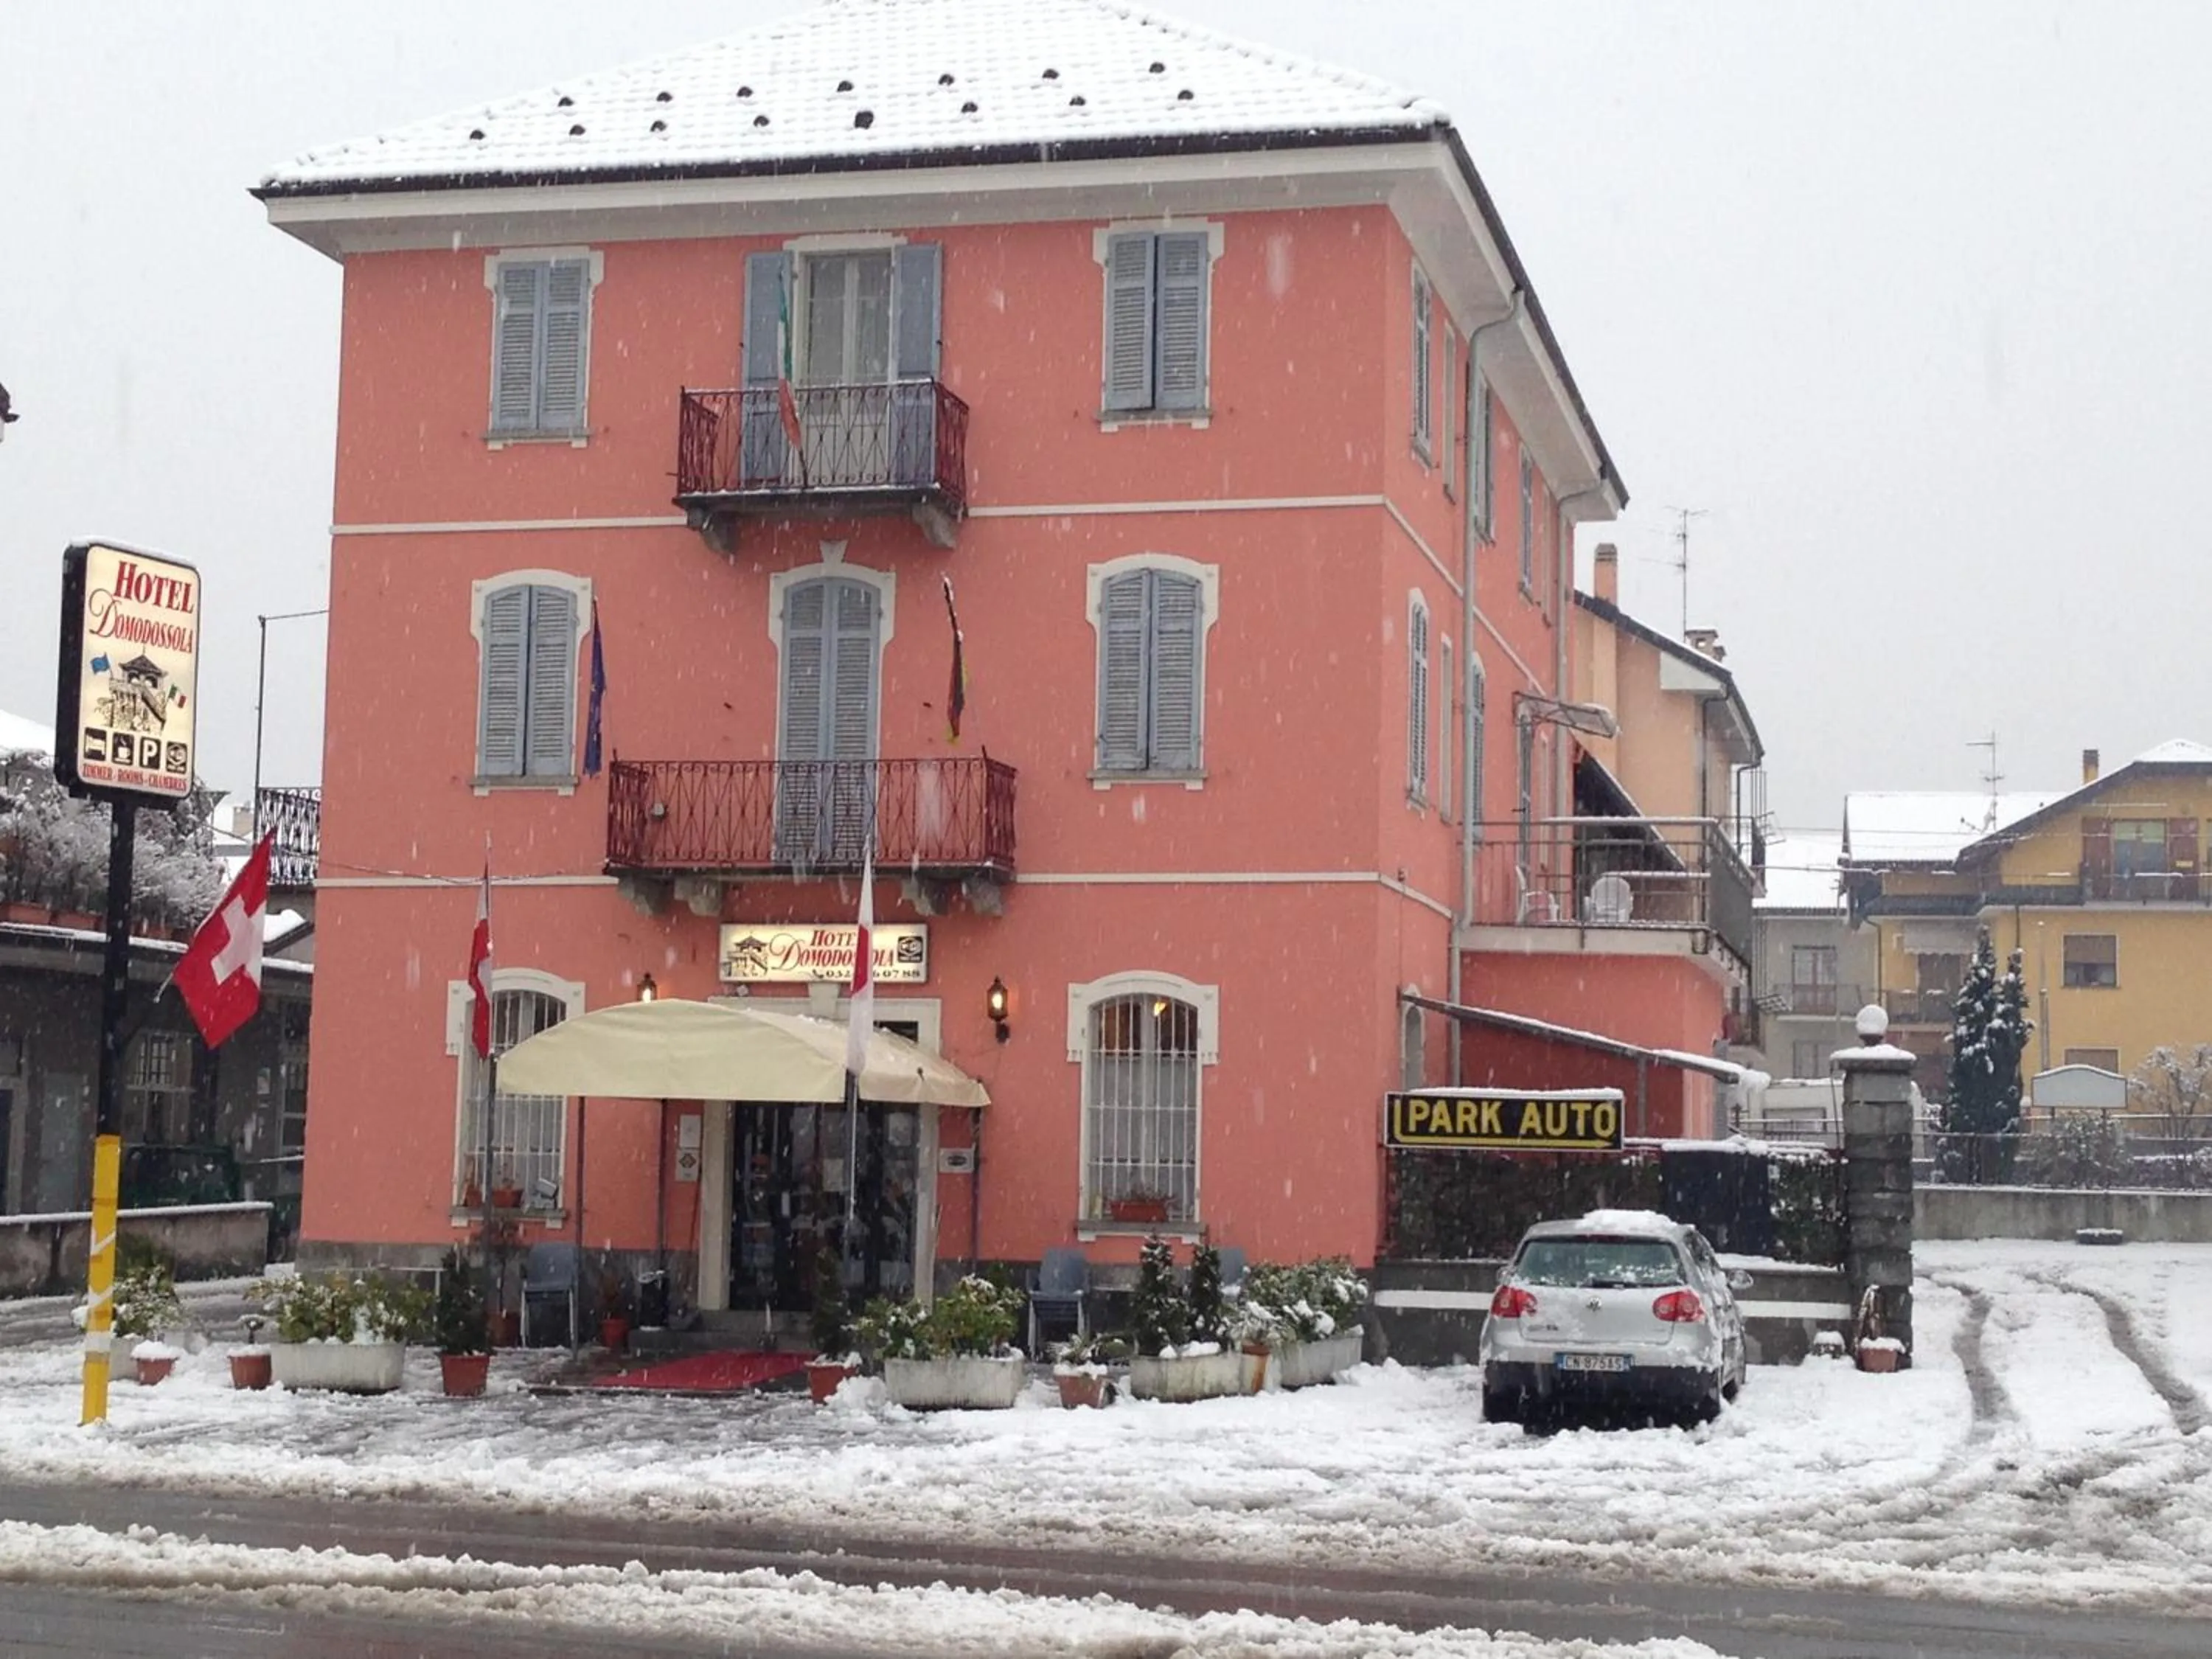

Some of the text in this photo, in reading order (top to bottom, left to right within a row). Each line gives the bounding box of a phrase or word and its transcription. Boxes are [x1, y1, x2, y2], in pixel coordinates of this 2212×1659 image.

[114, 560, 194, 614] HOTEL
[810, 930, 858, 947] HOTE
[1408, 1099, 1616, 1138] PARK AUTO
